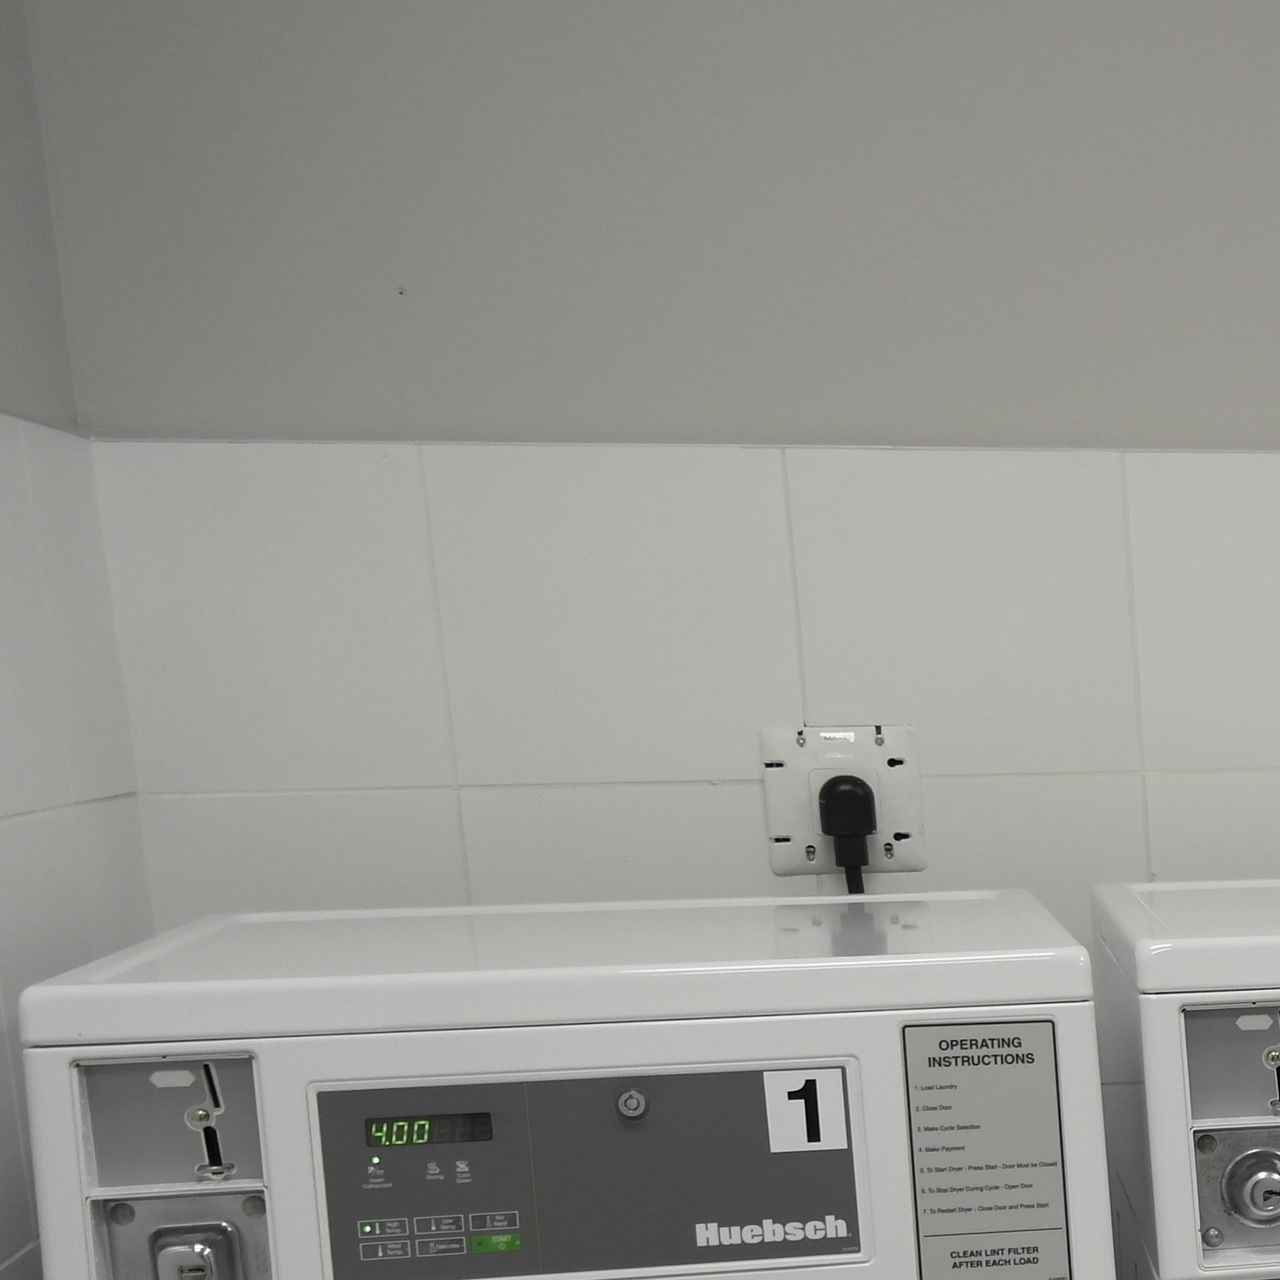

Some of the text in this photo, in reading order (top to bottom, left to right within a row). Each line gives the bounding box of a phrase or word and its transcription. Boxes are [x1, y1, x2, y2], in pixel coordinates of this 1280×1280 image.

[938, 1036, 1022, 1051] OPERATING
[928, 1052, 1035, 1068] INSTRUCTIONS
[787, 1079, 822, 1143] 1
[371, 1120, 430, 1145] 4.00
[695, 1215, 848, 1247] Huebsch
[950, 1246, 1039, 1259] CLEAN LINT FILTER
[952, 1256, 1039, 1269] AFTER EACH LOAD
